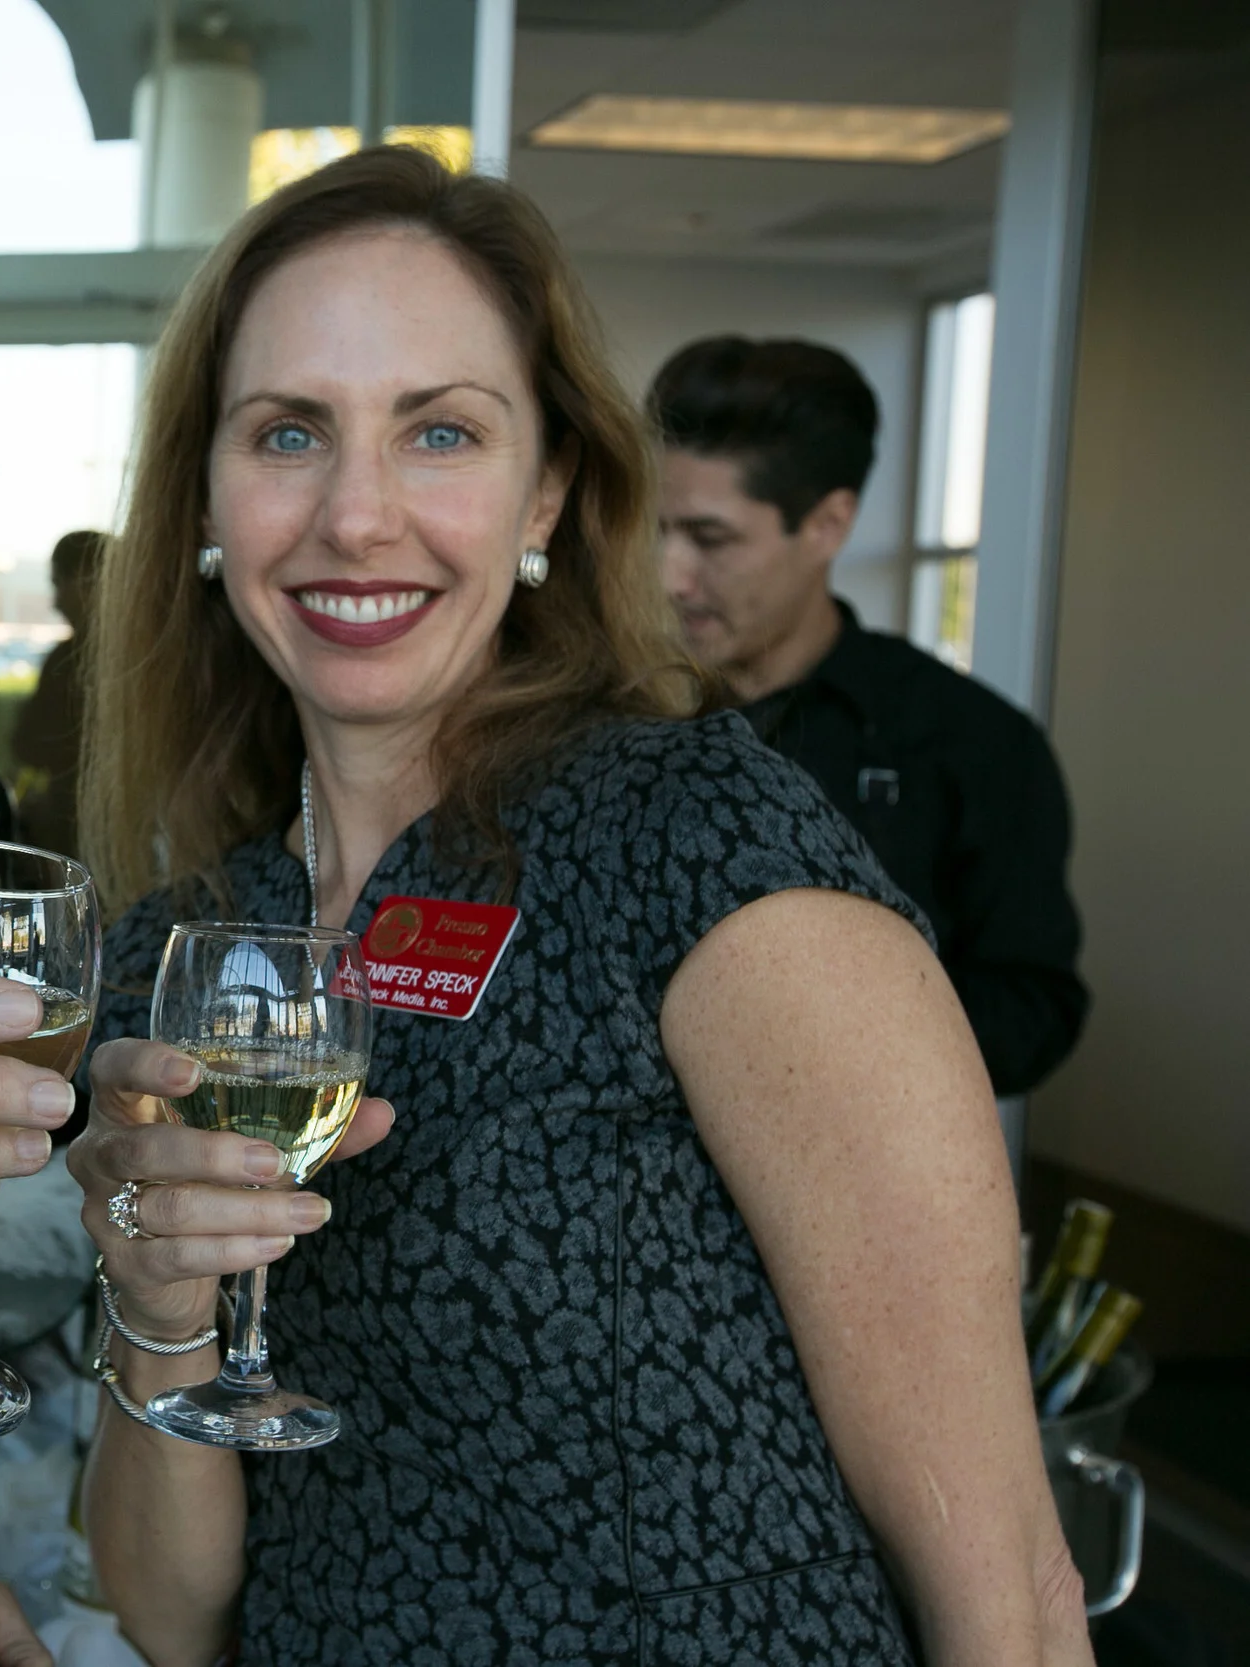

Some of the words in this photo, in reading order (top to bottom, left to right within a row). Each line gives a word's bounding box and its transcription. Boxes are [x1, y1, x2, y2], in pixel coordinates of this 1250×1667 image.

[415, 938, 486, 963] Chamber
[424, 970, 478, 995] SPECK
[429, 996, 449, 1010] Inc.
